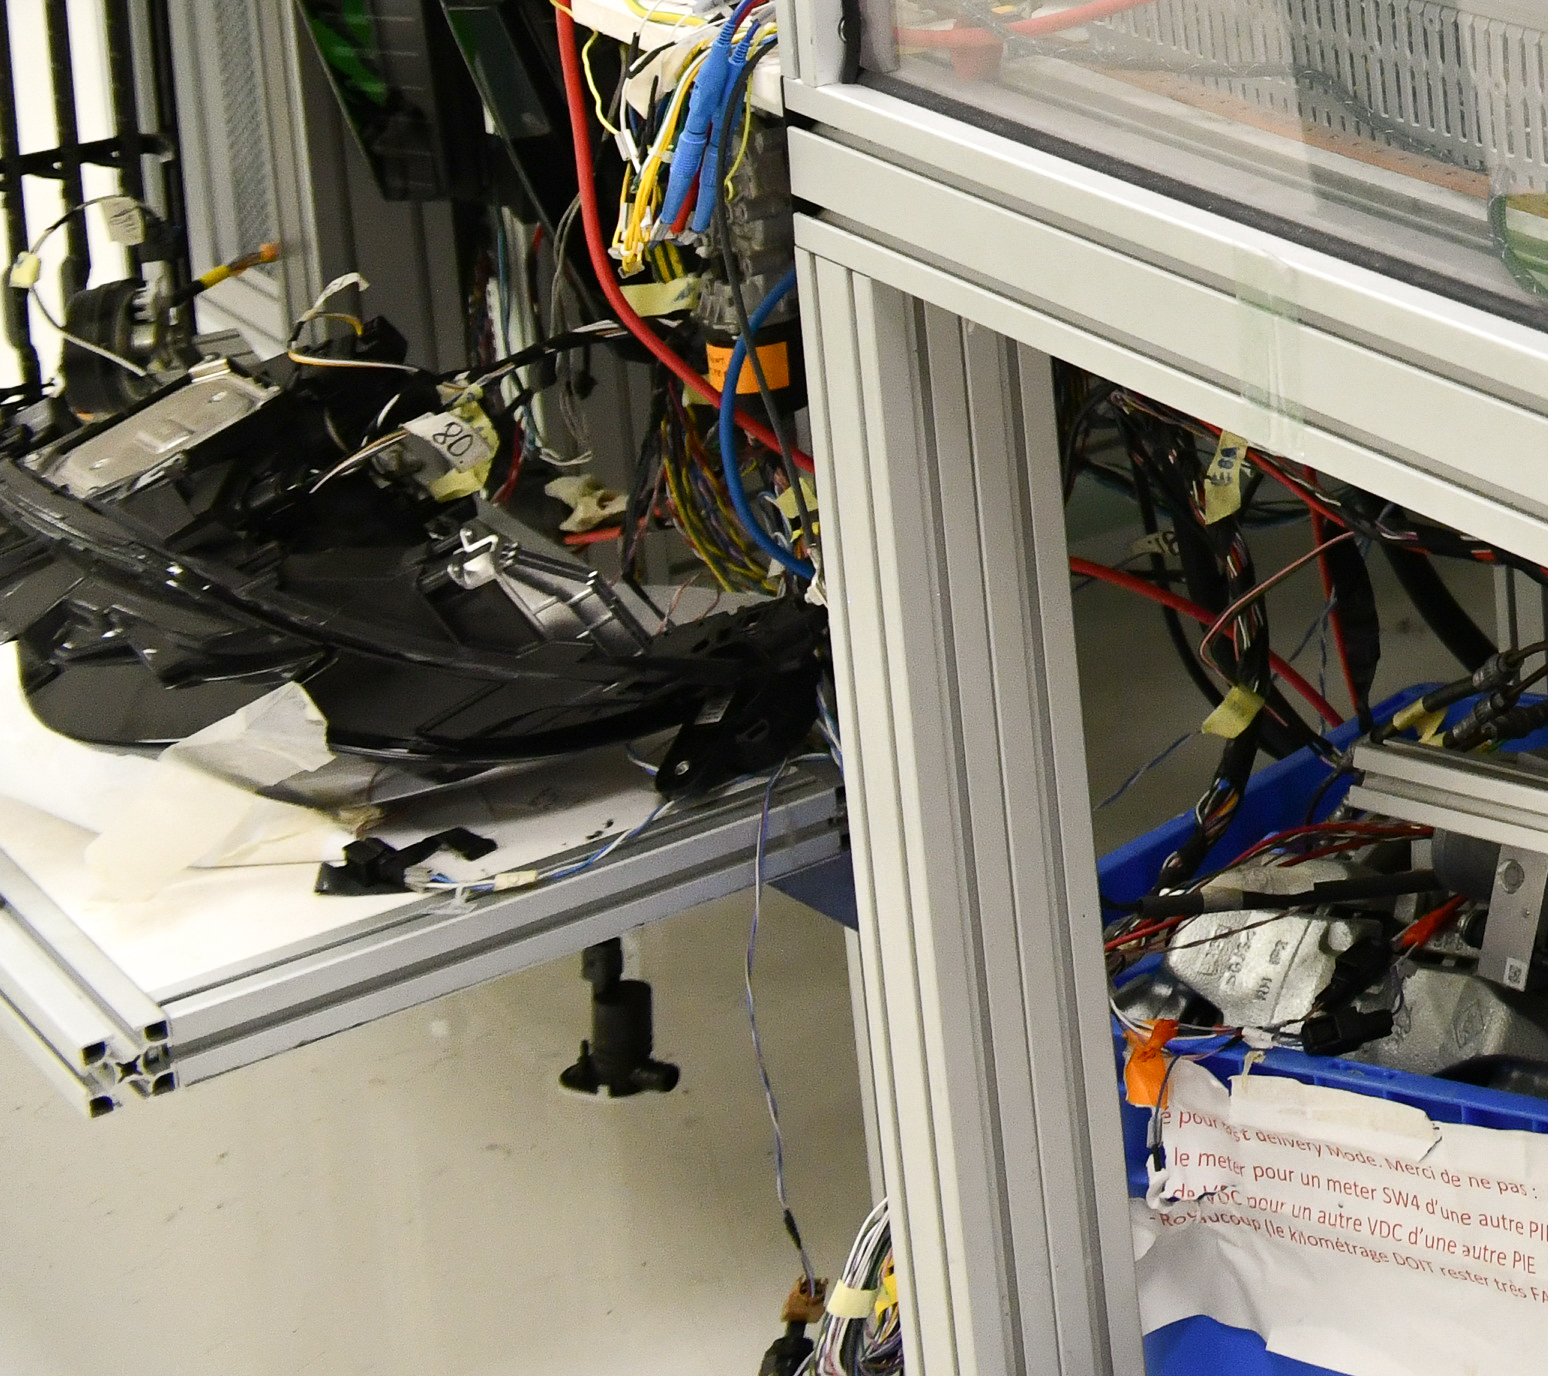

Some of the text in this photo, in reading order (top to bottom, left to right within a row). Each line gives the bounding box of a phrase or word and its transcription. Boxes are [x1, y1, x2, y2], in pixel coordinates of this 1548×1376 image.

[1174, 1147, 1190, 1167] le
[1198, 1152, 1245, 1177] meter
[1253, 1164, 1295, 1182] pour
[1300, 1172, 1321, 1189] un
[1326, 1178, 1377, 1201] meter
[1383, 1187, 1420, 1211] SW4
[1479, 1213, 1524, 1235] autre
[1179, 1110, 1218, 1128] pour
[1325, 1144, 1382, 1167] Mode.
[1385, 1157, 1436, 1181] Merci
[1440, 1169, 1461, 1187] de
[1468, 1175, 1491, 1190] ne
[1497, 1180, 1527, 1196] pas
[1291, 1203, 1312, 1222] un
[1317, 1210, 1362, 1233] autre
[1367, 1217, 1403, 1242] VDC
[1462, 1244, 1507, 1266] autre
[1512, 1250, 1536, 1274] PIE
[1393, 1252, 1434, 1273] DOIT
[1439, 1267, 1489, 1287] rester
[1494, 1277, 1527, 1299] très
